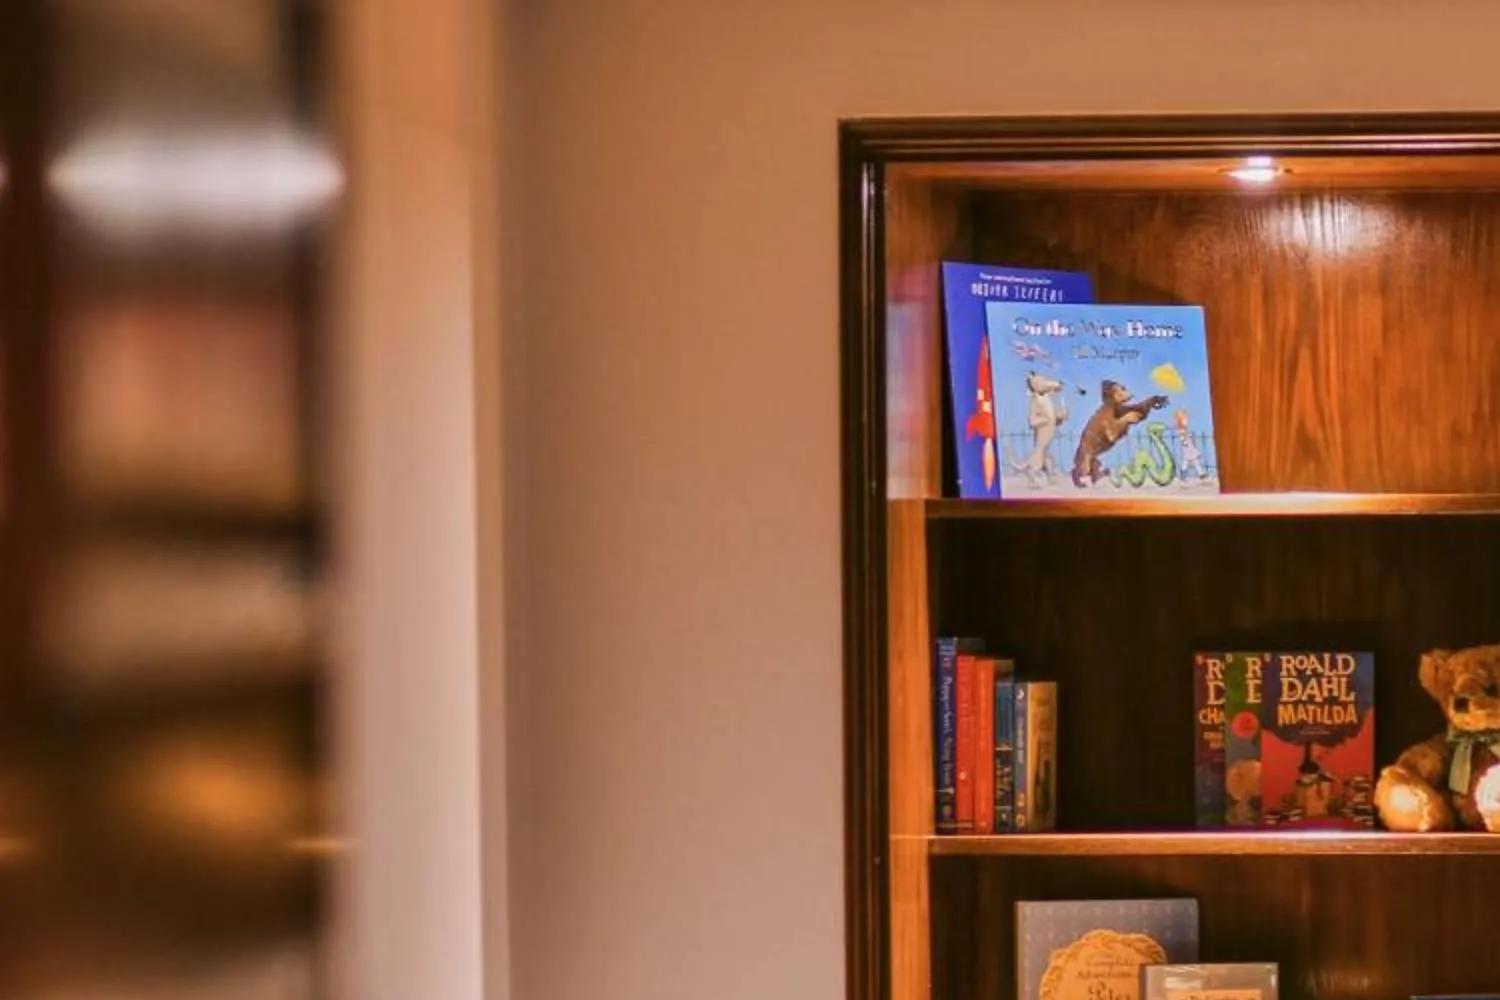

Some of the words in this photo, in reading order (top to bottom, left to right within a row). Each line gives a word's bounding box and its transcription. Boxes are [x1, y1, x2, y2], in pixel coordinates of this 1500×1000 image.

[1012, 317, 1043, 337] On
[1126, 319, 1184, 339] Home
[1279, 653, 1356, 677] ROALD
[1279, 677, 1356, 703] DAHL
[1276, 703, 1358, 726] MATILDA
